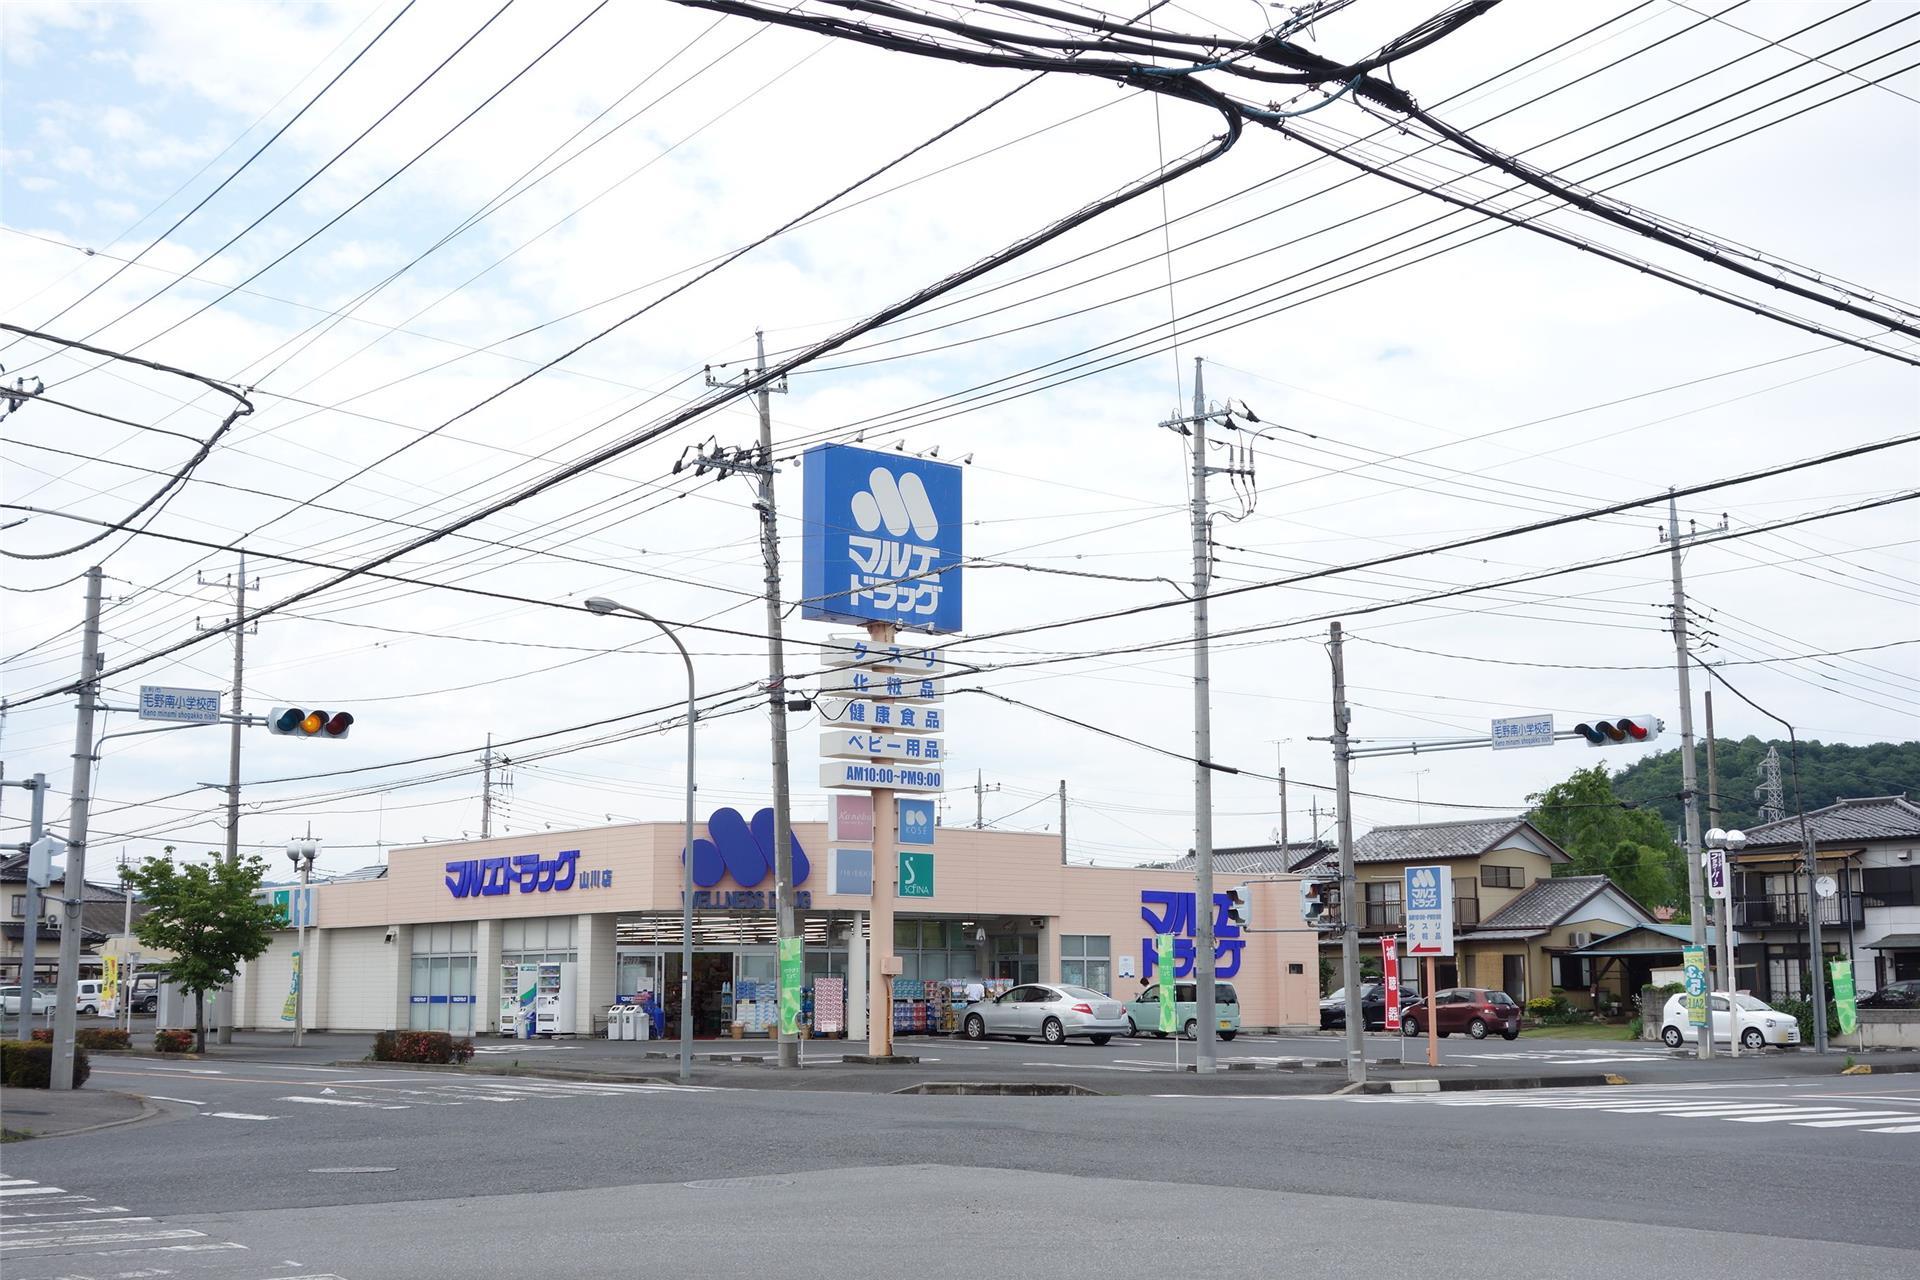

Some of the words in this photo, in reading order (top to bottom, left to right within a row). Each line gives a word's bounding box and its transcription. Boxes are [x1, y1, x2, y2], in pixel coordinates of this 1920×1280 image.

[848, 535, 940, 583] マルエ
[850, 574, 944, 615] ドラッグ
[854, 642, 935, 669] クスリ
[853, 673, 935, 699] 化粧品
[143, 693, 217, 711] 毛野南小学校西
[849, 703, 940, 729] 健康食品
[1494, 721, 1551, 739] 毛野南小学校西
[848, 736, 939, 758] ベビー用品
[445, 850, 580, 898] マルエドラッグ
[579, 870, 613, 889] 山川店
[904, 885, 929, 894] SOFINA
[1412, 888, 1437, 899] マルエ
[1412, 898, 1438, 908] ドラッグ
[1409, 922, 1441, 930] クスリ
[1142, 938, 1246, 979] ドラグ
